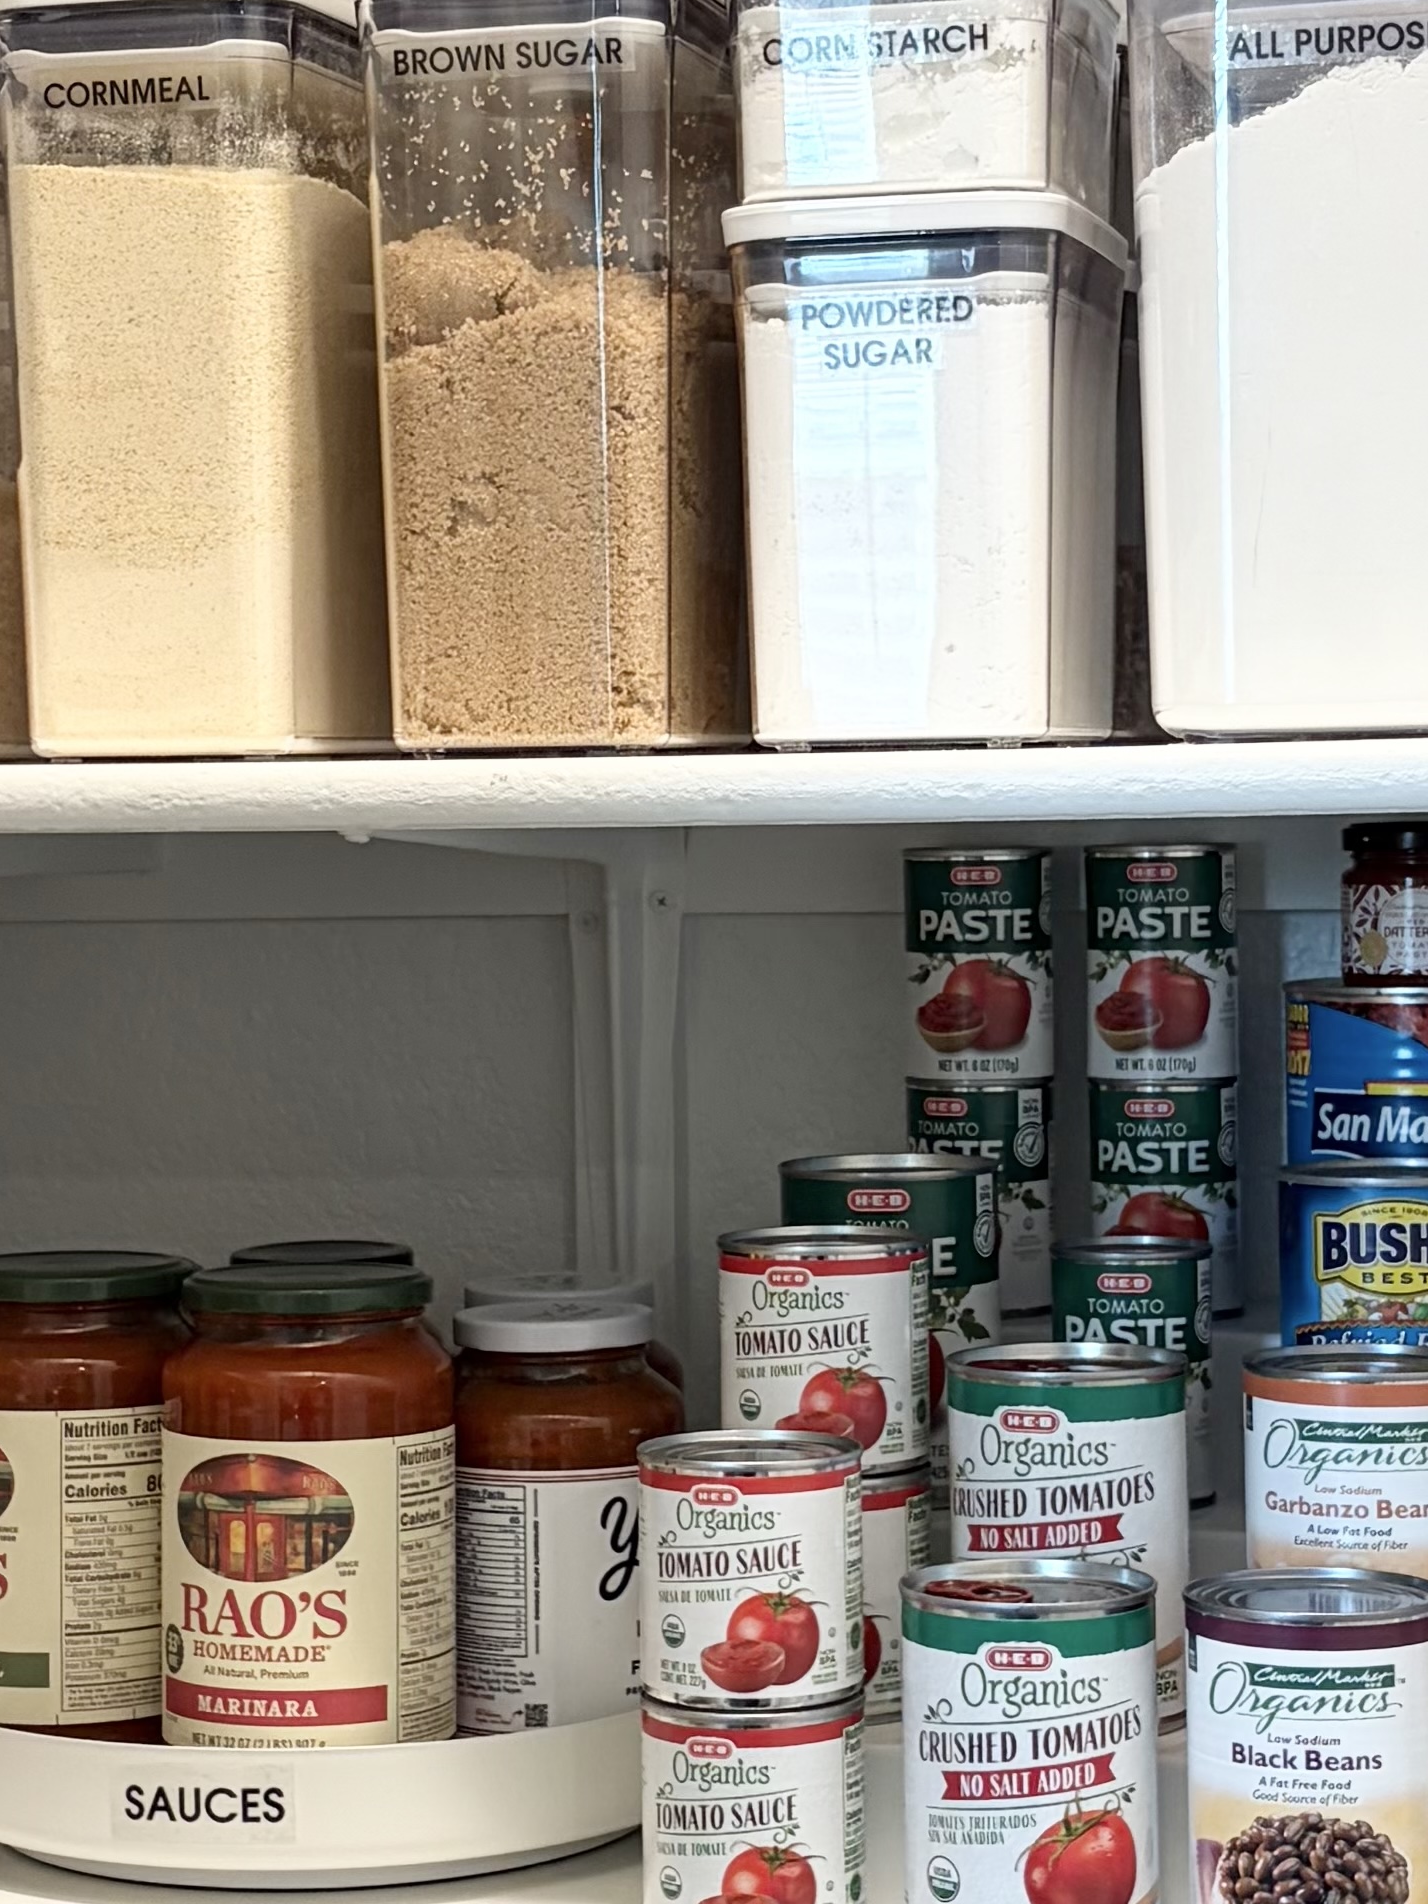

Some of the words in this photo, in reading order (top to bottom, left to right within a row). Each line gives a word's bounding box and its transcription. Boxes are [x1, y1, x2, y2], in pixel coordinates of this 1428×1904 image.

[391, 41, 507, 77] BROWN
[515, 34, 623, 71] SUGAR
[761, 31, 858, 67] CORN
[867, 21, 989, 59] STARCH
[1229, 29, 1284, 63] ALL
[43, 73, 211, 111] CORNMEAL
[800, 293, 974, 330] POWDERED
[822, 336, 933, 371] SUGAR
[941, 890, 1013, 906] TOMATO
[1117, 886, 1189, 904] TOMATO
[919, 908, 1033, 942] PASTE
[1097, 905, 1212, 939] PASTE
[1318, 1105, 1375, 1146] San
[750, 1284, 845, 1319] Organics
[733, 1328, 802, 1357] TOMATO
[806, 1319, 871, 1352] SAUCE
[1264, 1492, 1369, 1520] Garbanzo
[181, 1581, 349, 1642] RAO'S
[192, 1641, 327, 1666] HOMEMADE
[196, 1693, 319, 1720] MARINARA
[961, 1662, 1103, 1719] Organics
[1209, 1660, 1404, 1734] Organics
[919, 1728, 1019, 1764] CRUSHED
[1029, 1705, 1142, 1760] TOMATOES
[672, 1751, 772, 1789] Organics
[1231, 1743, 1298, 1770] Black
[1305, 1749, 1383, 1772] Beans
[959, 1775, 984, 1799] NO
[988, 1769, 1032, 1796] SALT
[1036, 1762, 1096, 1793] ADDED
[124, 1783, 286, 1825] SAUCES
[655, 1802, 725, 1832] TOMATO
[730, 1793, 798, 1827] SAUCE
